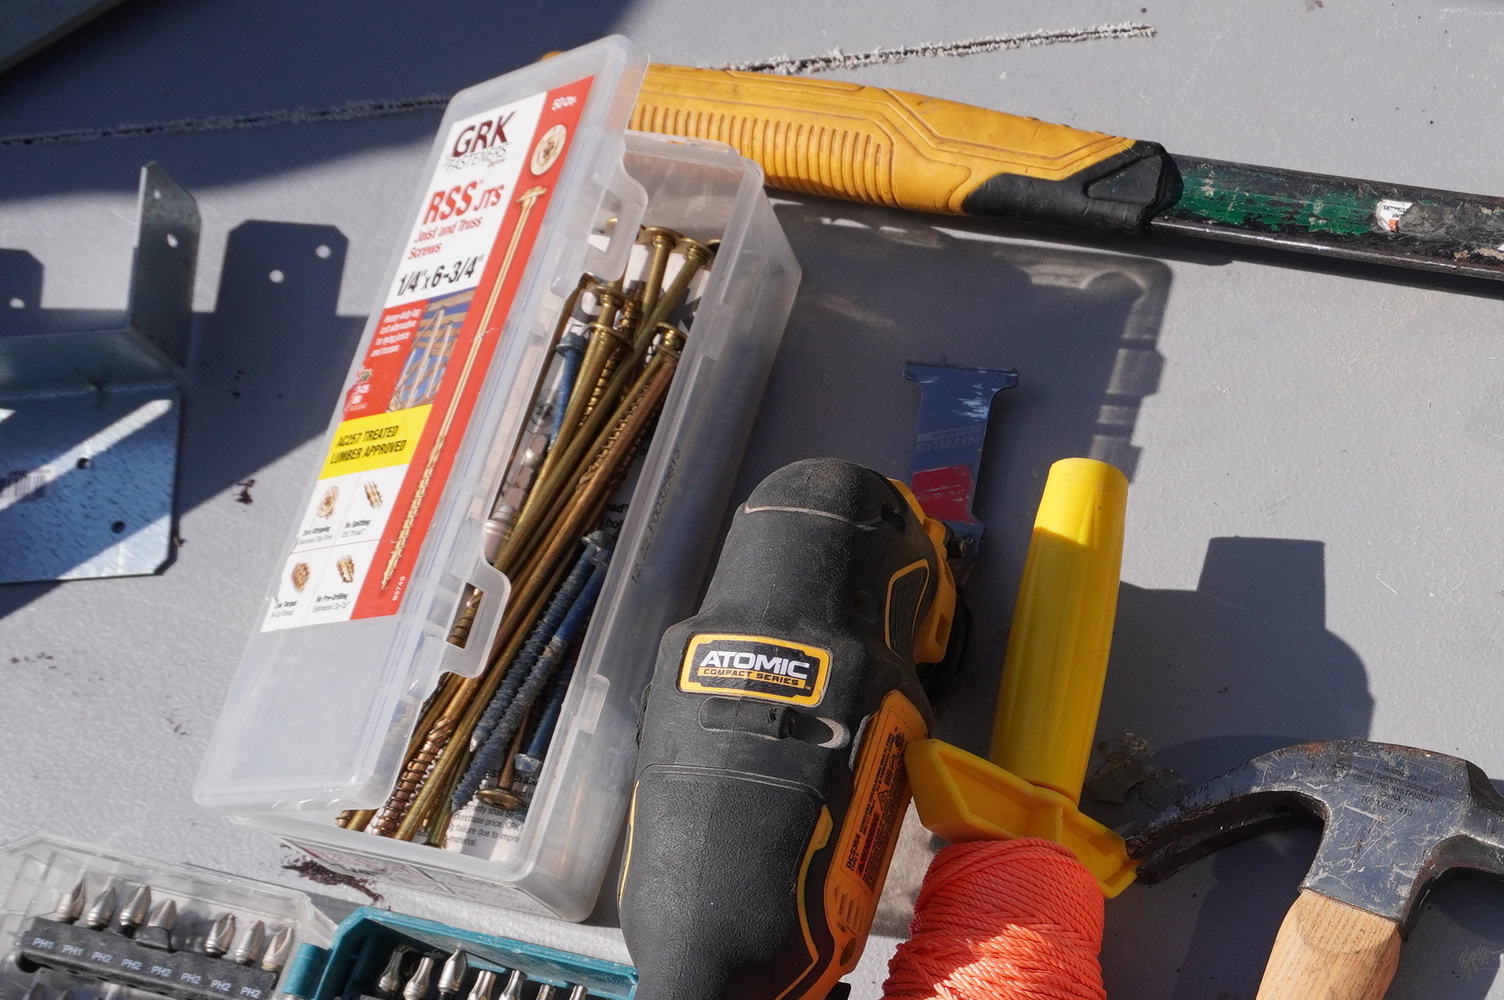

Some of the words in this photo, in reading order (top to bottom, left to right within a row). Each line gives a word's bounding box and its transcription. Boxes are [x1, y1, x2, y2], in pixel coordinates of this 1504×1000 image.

[453, 111, 516, 157] GRK
[422, 181, 477, 225] RSS
[473, 185, 504, 211] JTS
[414, 227, 437, 243] Joist
[438, 221, 457, 237] and
[459, 217, 482, 232] Truss
[408, 243, 442, 260] Screws
[363, 425, 399, 442] TREATED
[330, 448, 362, 464] LUMBER
[362, 440, 406, 458] APPROVED
[700, 651, 810, 679] ATOMIC
[703, 668, 752, 677] COMPACT
[756, 674, 799, 685] SERIES
[858, 812, 881, 862] WARNING
[32, 938, 54, 950] PH1
[62, 943, 84, 957] PH1
[91, 951, 114, 964] PH2
[121, 958, 143, 971] PH2
[151, 965, 173, 978] PH2
[181, 971, 203, 985] PH2
[210, 978, 232, 992] PH2
[240, 985, 263, 999] PH2
